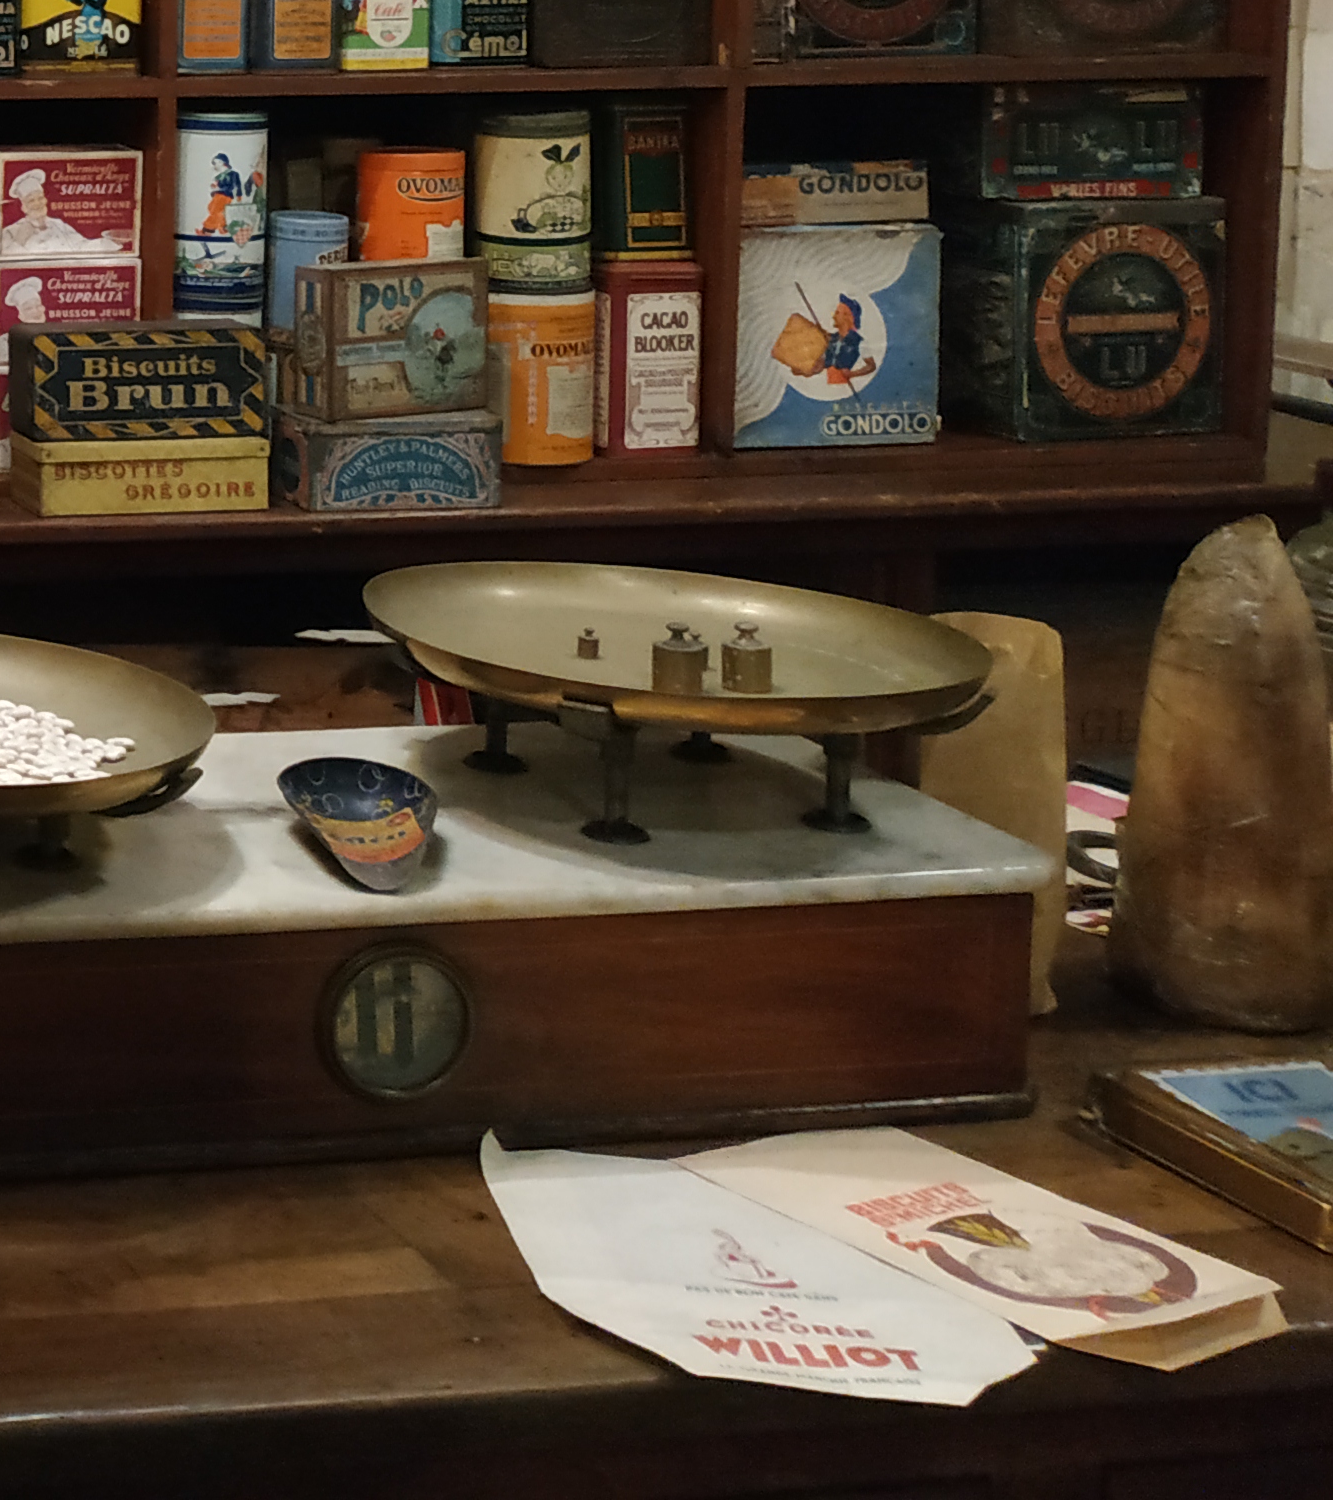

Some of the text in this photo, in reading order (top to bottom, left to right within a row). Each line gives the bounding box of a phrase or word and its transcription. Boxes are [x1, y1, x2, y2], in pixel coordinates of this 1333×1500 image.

[45, 15, 130, 46] NESCAO
[798, 172, 924, 196] GONDOLO
[357, 277, 424, 334] POLO
[640, 311, 688, 330] CACAO
[634, 334, 696, 353] BLOOKER
[82, 355, 217, 380] Biscuits
[66, 379, 234, 413] Brun
[823, 414, 932, 435] GONDOLO
[54, 461, 185, 481] BISCOTTES
[365, 461, 443, 478] SUPERIOR
[125, 479, 256, 501] GRÉGOIRE
[706, 1319, 875, 1339] CHICORÉE
[693, 1334, 921, 1371] WILLIOT
